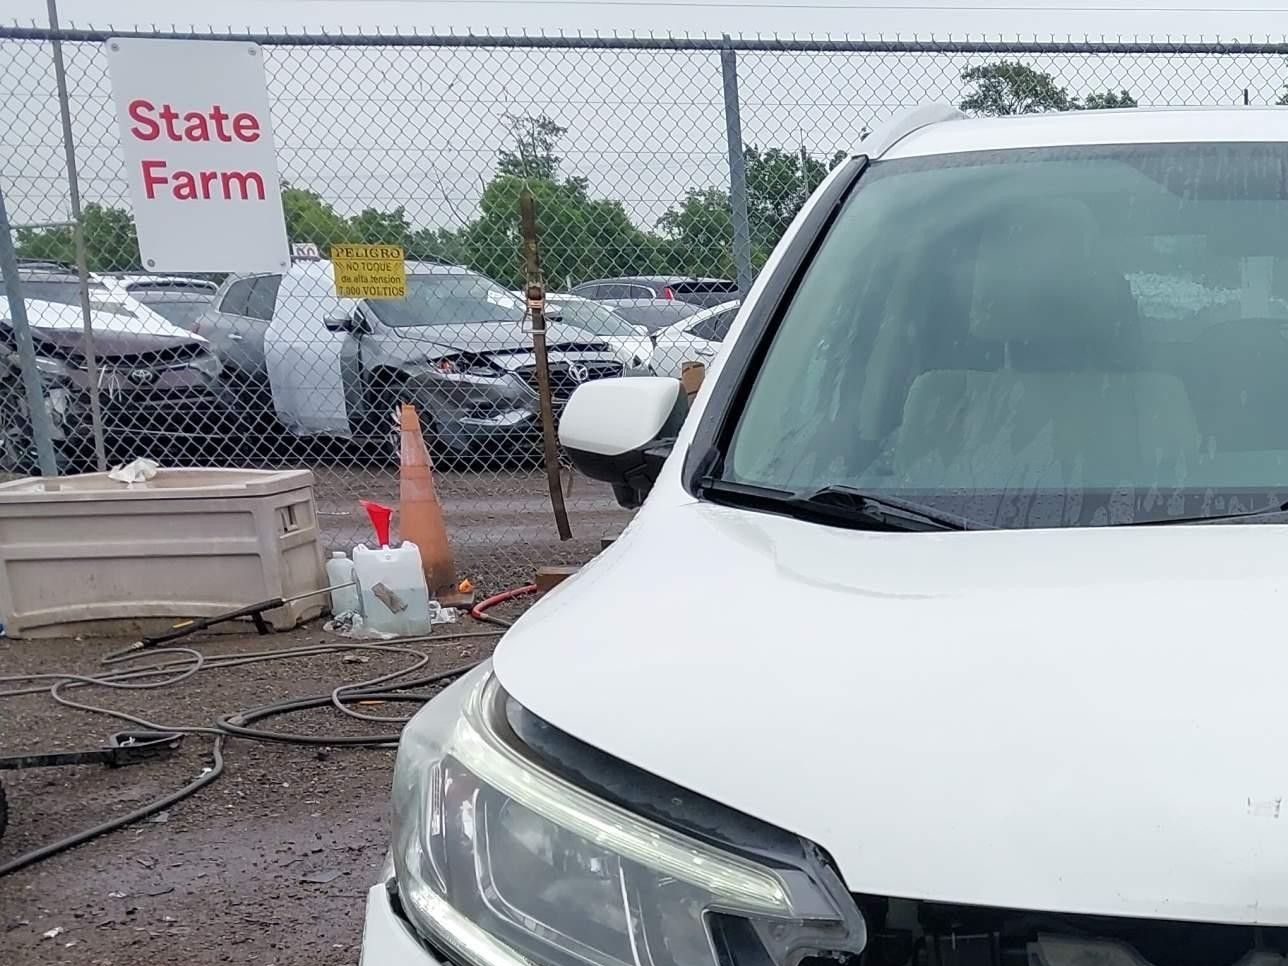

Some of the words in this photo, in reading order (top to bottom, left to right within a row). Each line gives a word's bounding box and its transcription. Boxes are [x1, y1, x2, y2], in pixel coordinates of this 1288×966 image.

[128, 99, 261, 142] State
[141, 160, 266, 200] Farm
[335, 247, 400, 259] PELIGRO
[346, 261, 359, 271] NO
[361, 261, 392, 273] TOQUE
[362, 286, 405, 297] VOLTIOS
